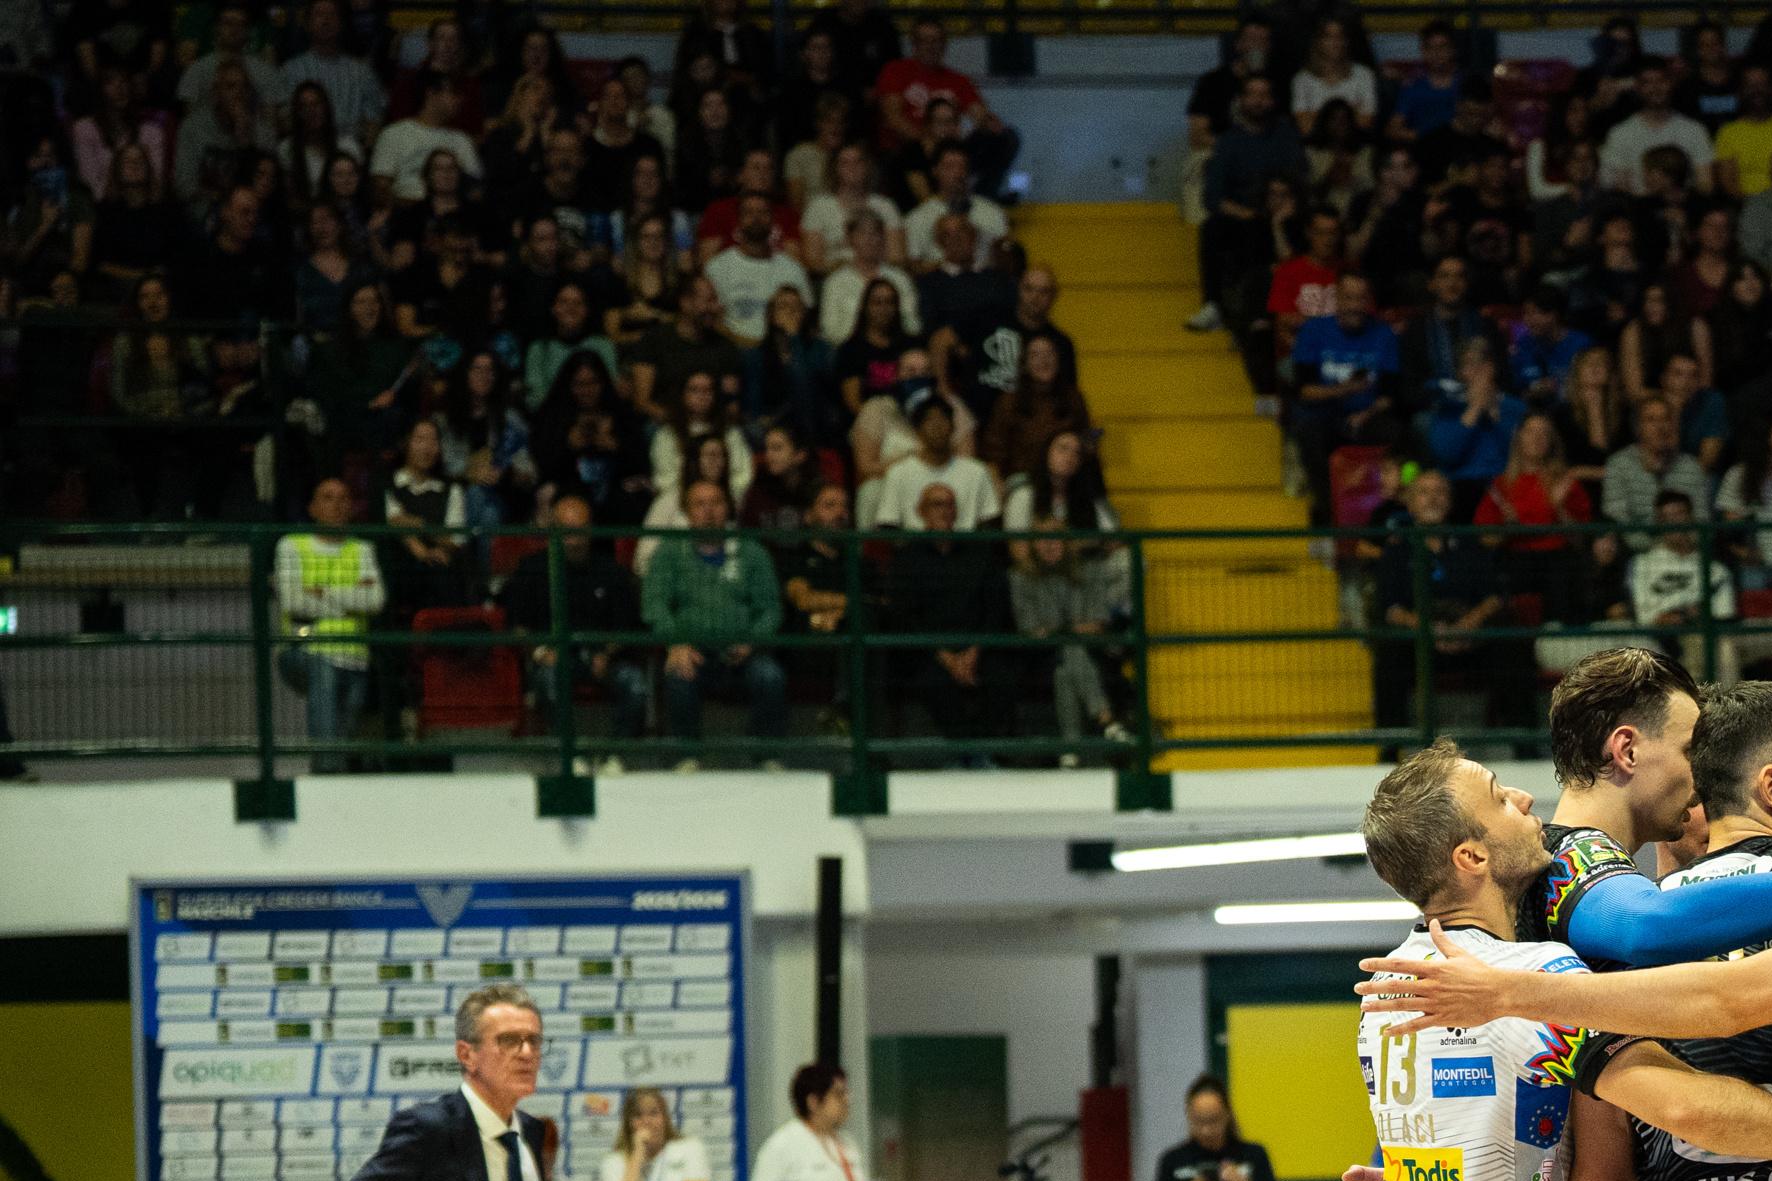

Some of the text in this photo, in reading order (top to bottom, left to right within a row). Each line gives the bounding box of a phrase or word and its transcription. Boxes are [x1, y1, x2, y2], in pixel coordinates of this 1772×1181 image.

[1440, 1036, 1477, 1046] adrenalina
[1379, 1022, 1417, 1106] 13
[1434, 1067, 1493, 1081] MONTEDIL
